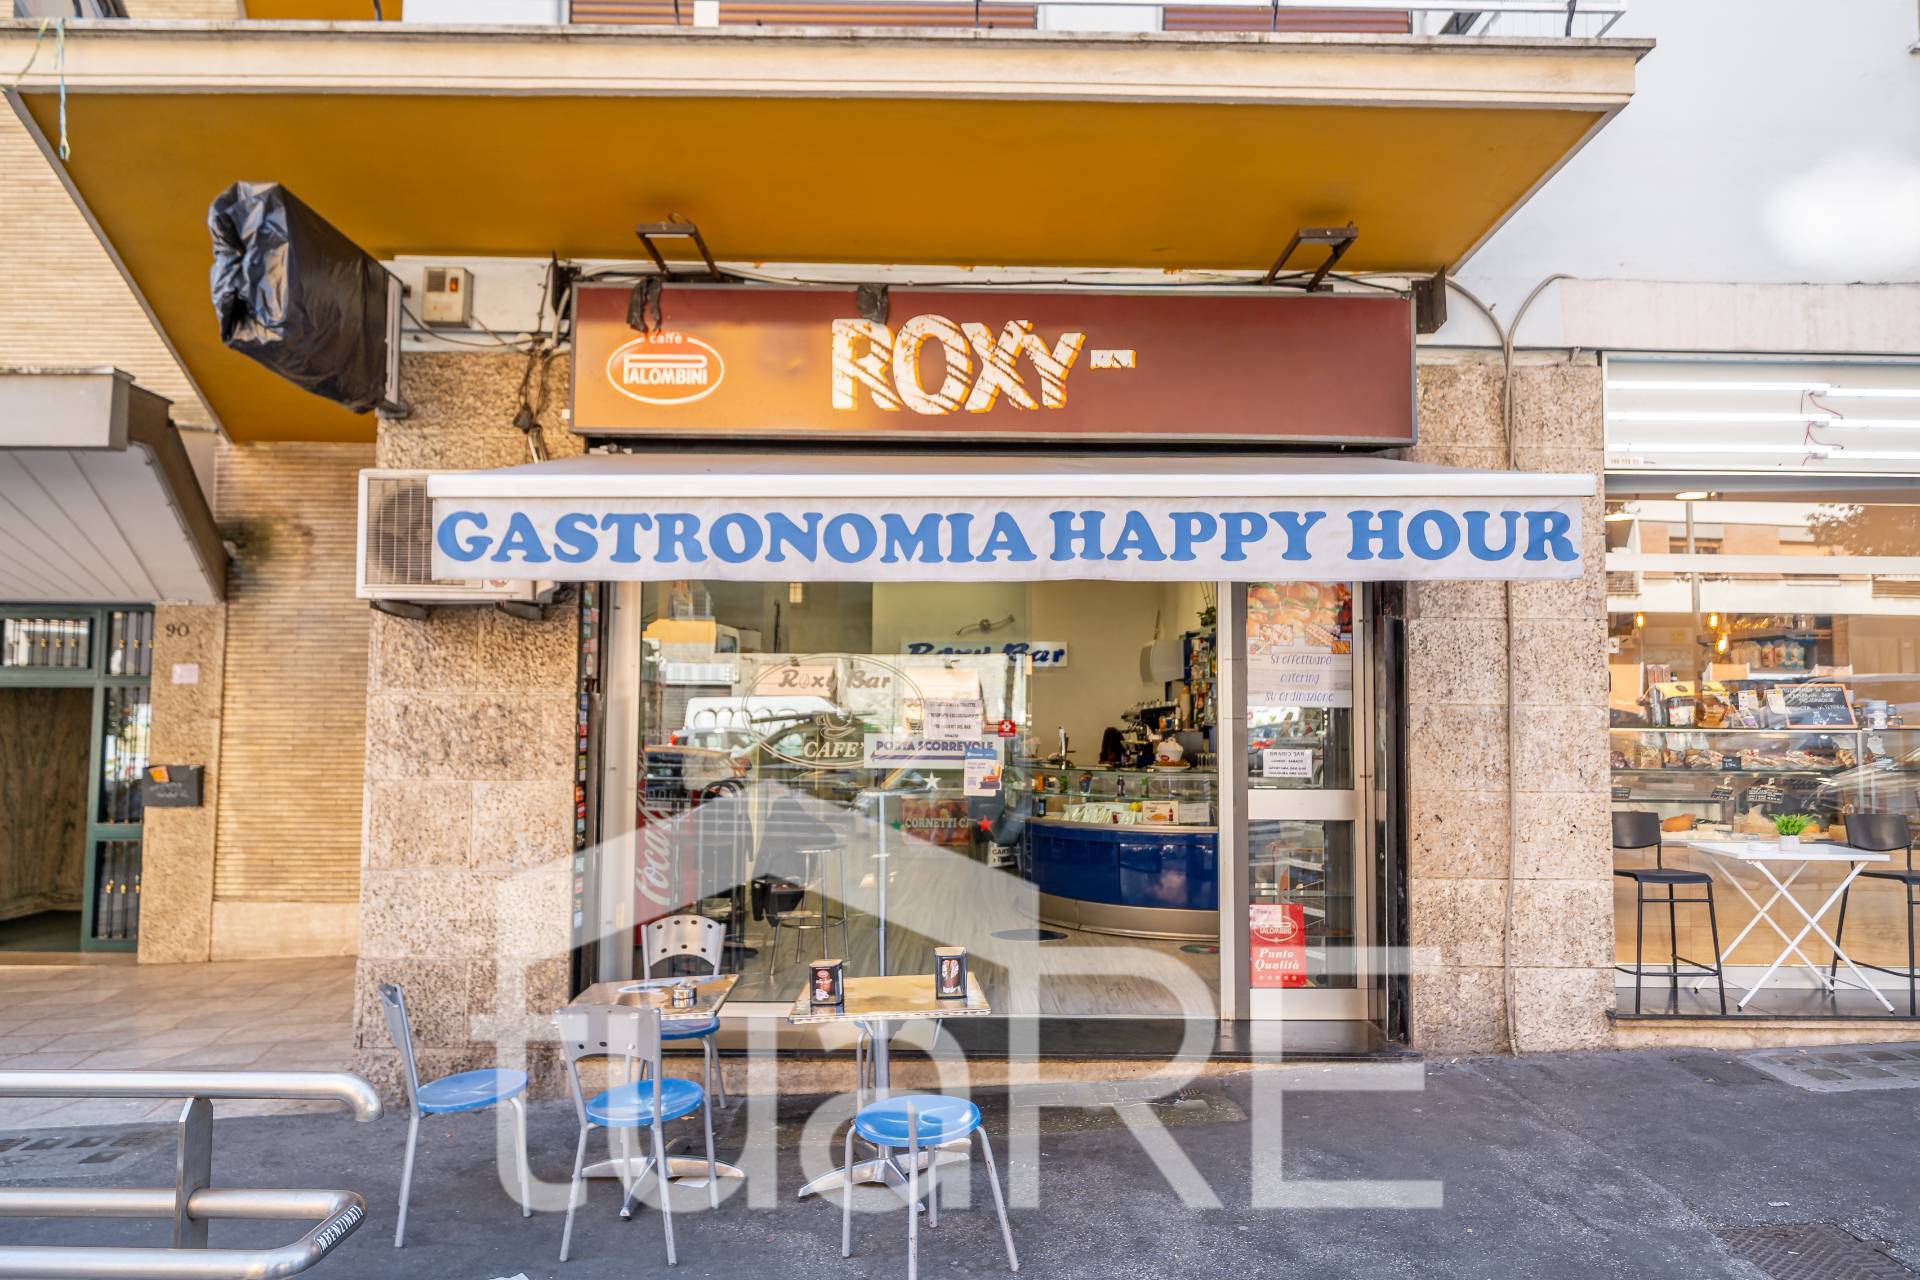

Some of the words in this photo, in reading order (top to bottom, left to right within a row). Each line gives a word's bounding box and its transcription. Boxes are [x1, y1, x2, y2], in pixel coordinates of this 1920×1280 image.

[623, 354, 708, 385] PALOMBINI
[437, 511, 1037, 564] GASTRONOMIA
[1049, 510, 1326, 562] HAPPY
[1347, 509, 1579, 562] HOUR
[166, 623, 191, 638] 90
[845, 670, 891, 688] Bar
[904, 816, 957, 829] CORNETTI
[1259, 948, 1294, 958] Punto
[1255, 959, 1300, 972] Qualità
